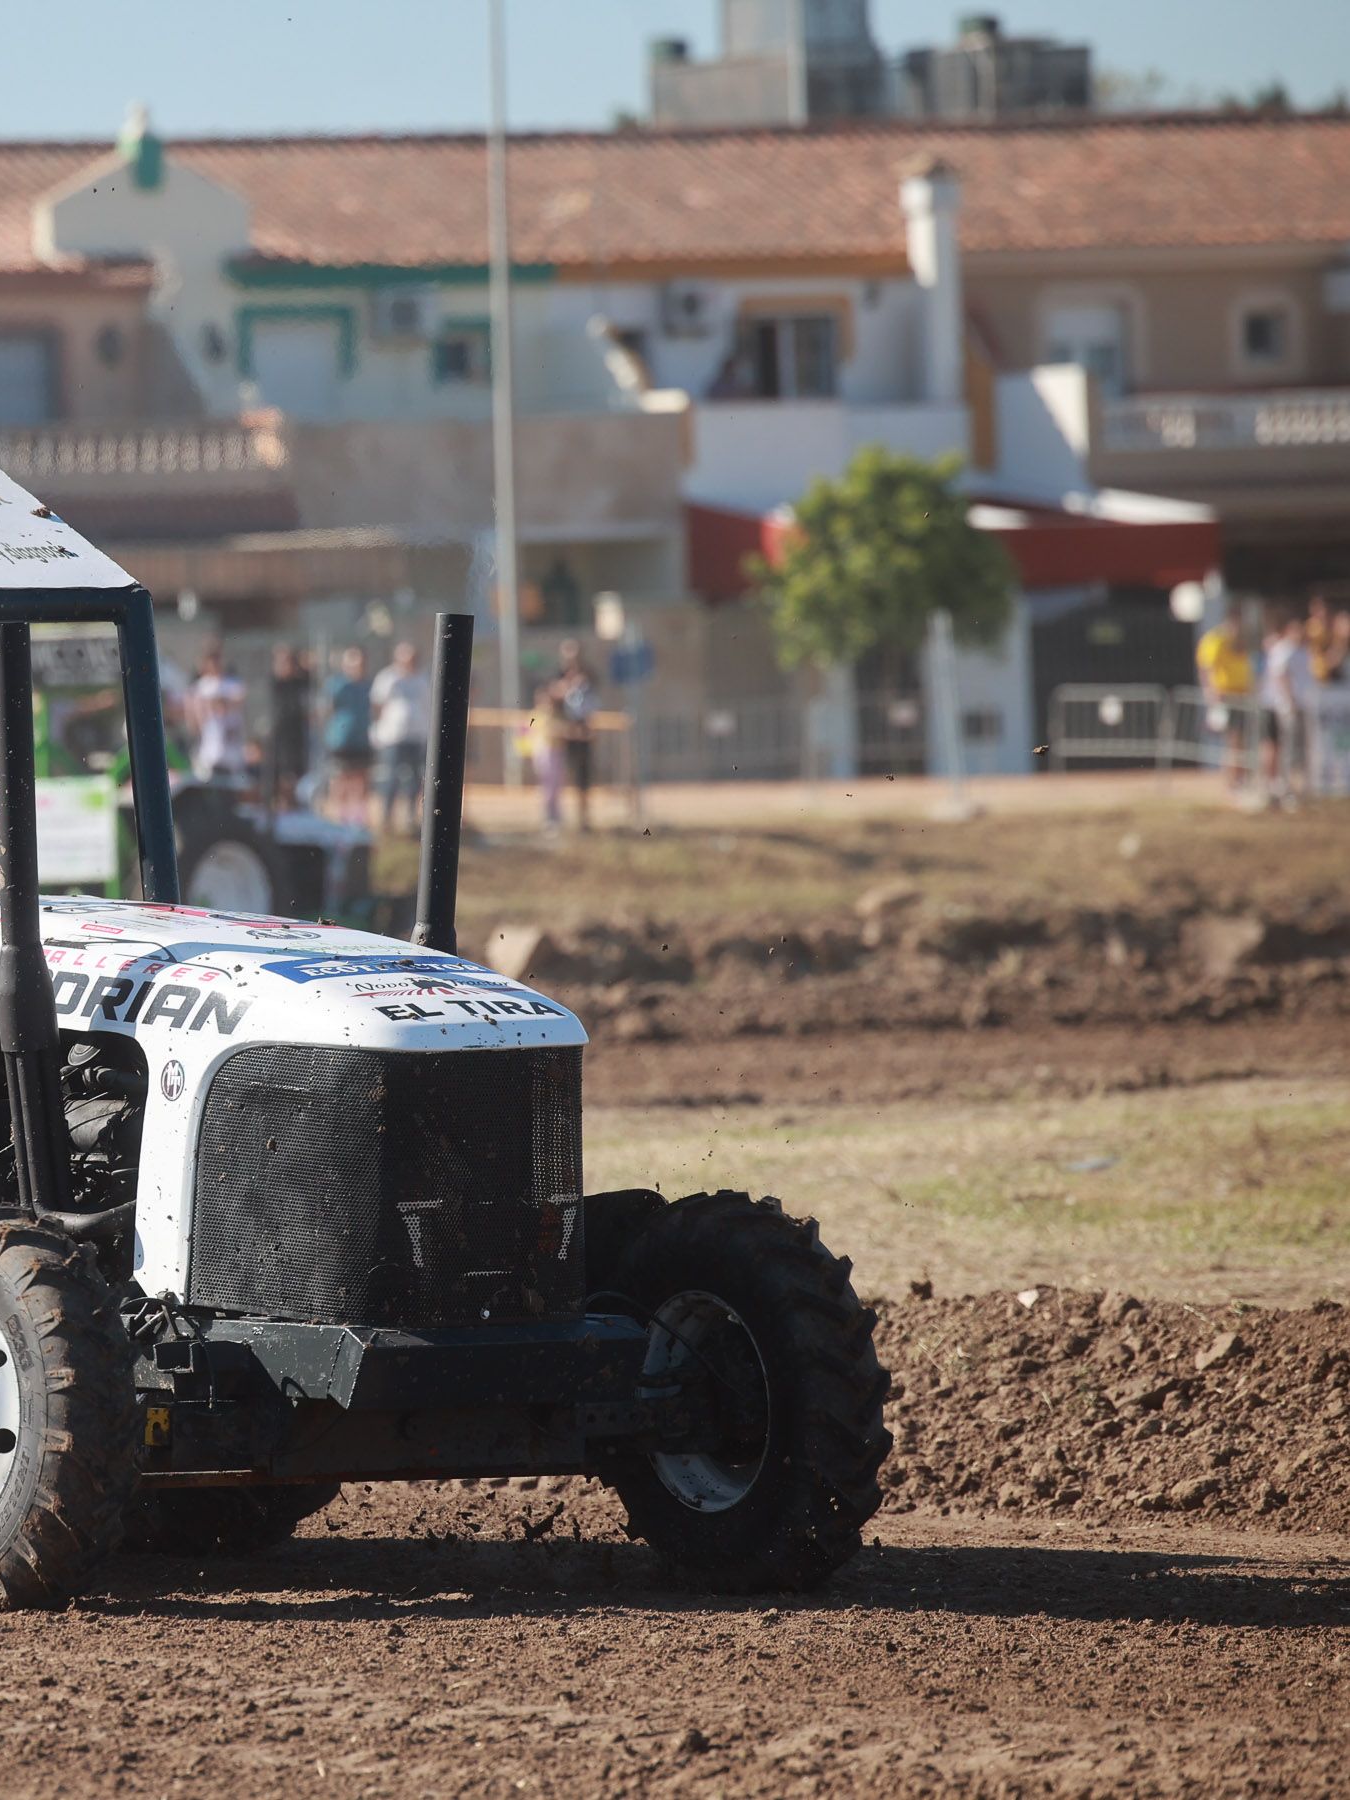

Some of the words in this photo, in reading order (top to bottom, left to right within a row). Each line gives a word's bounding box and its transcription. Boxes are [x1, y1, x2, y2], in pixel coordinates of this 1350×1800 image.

[49, 969, 254, 1035] DRIAN
[374, 1003, 445, 1022] EL
[443, 1000, 567, 1018] TIRA
